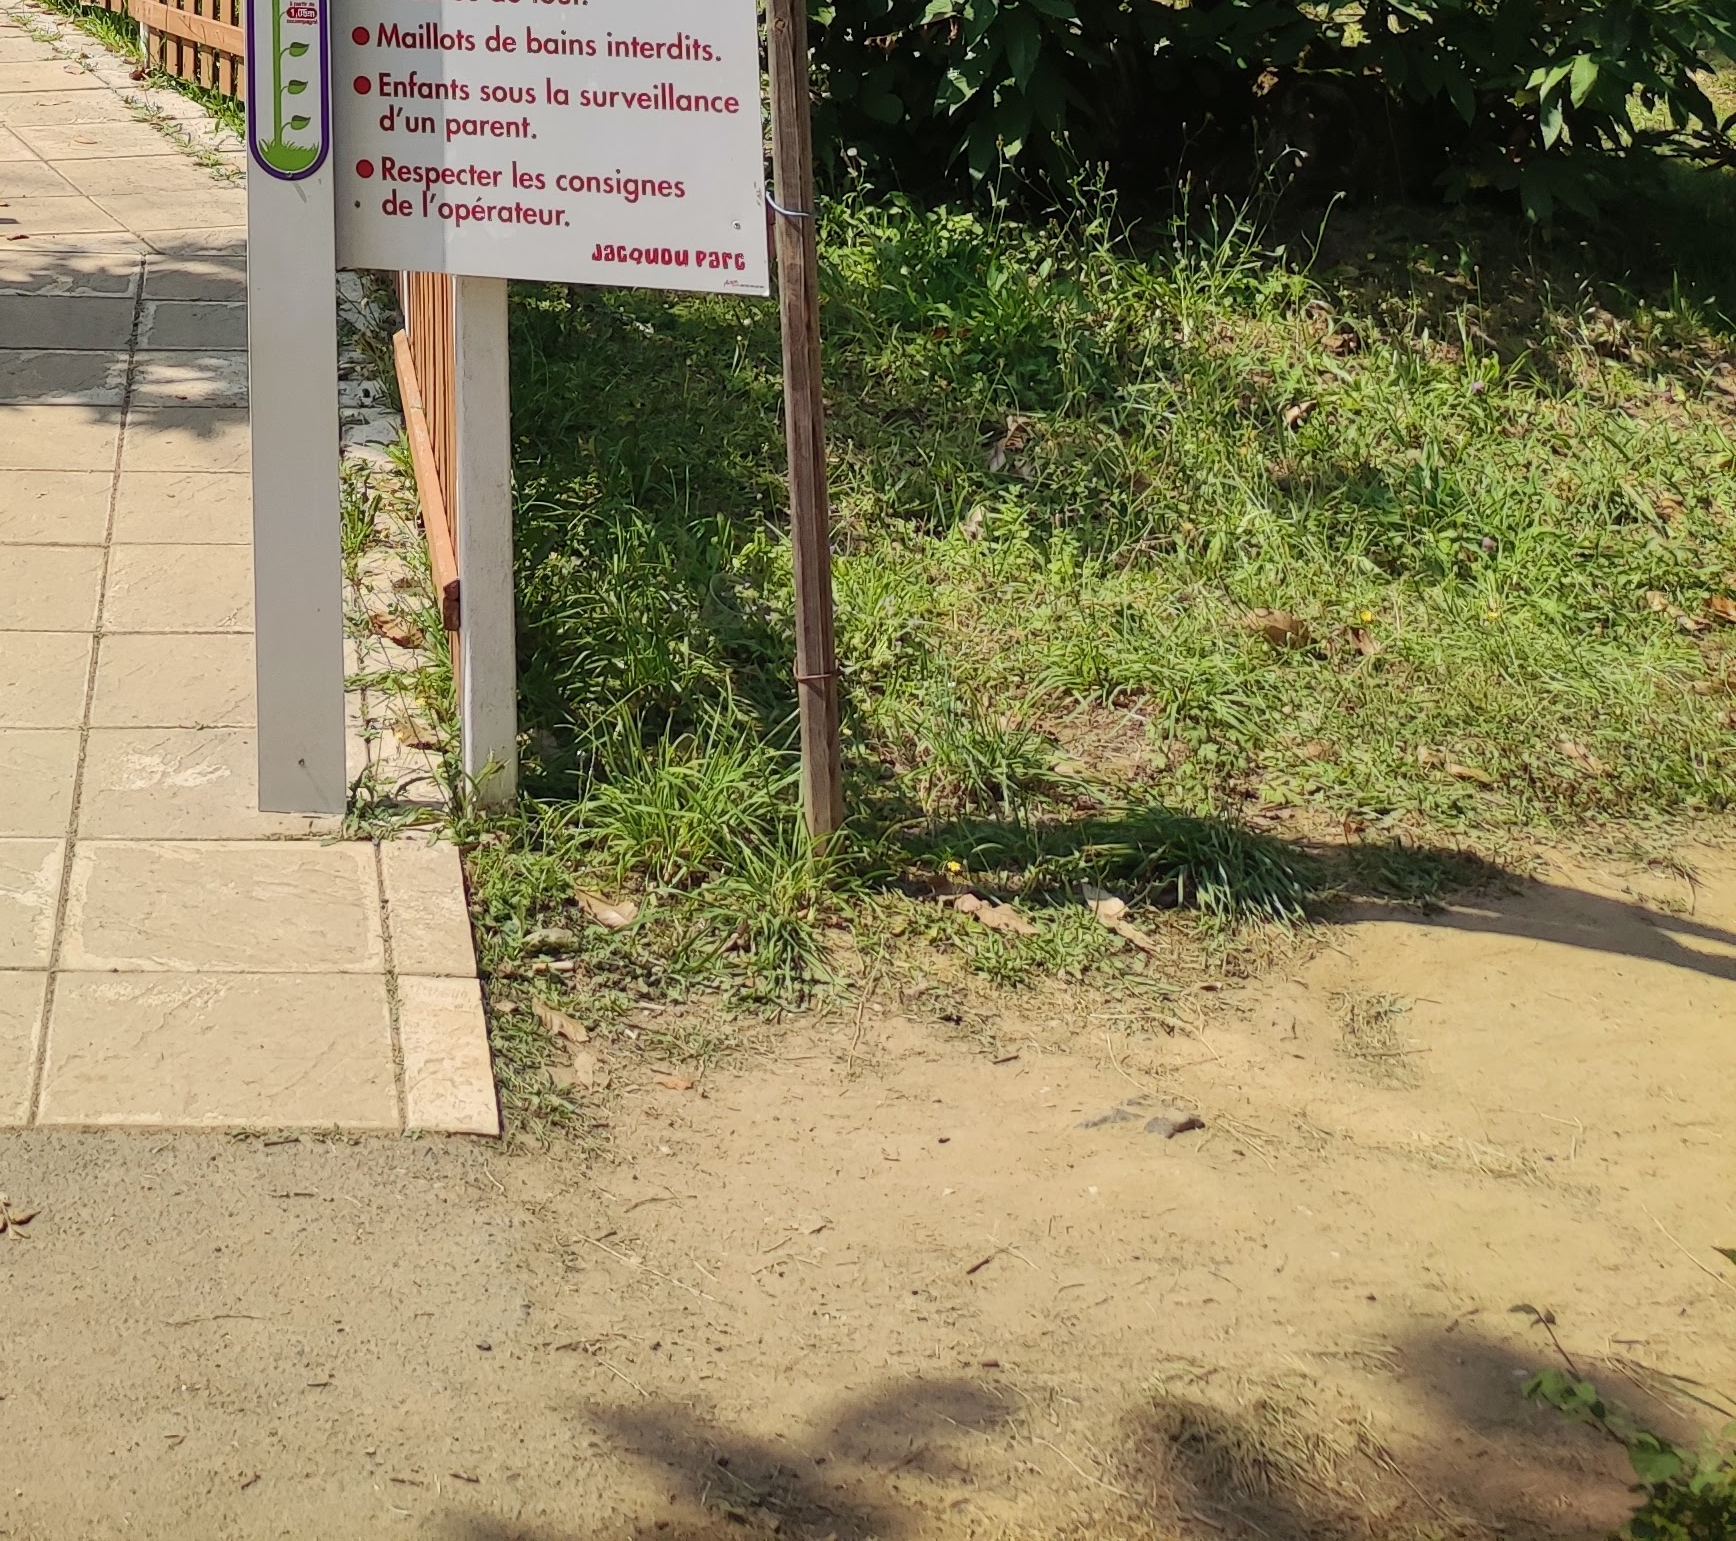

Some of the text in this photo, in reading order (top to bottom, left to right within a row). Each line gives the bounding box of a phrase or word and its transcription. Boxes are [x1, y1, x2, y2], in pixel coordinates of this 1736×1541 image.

[377, 22, 722, 62] Maillots de bains interdits.
[379, 71, 740, 114] Enfants sous la surveillance
[379, 104, 537, 142] d'un parent.
[381, 156, 686, 203] Respecter les consignes
[382, 189, 570, 227] de l'opérateur.
